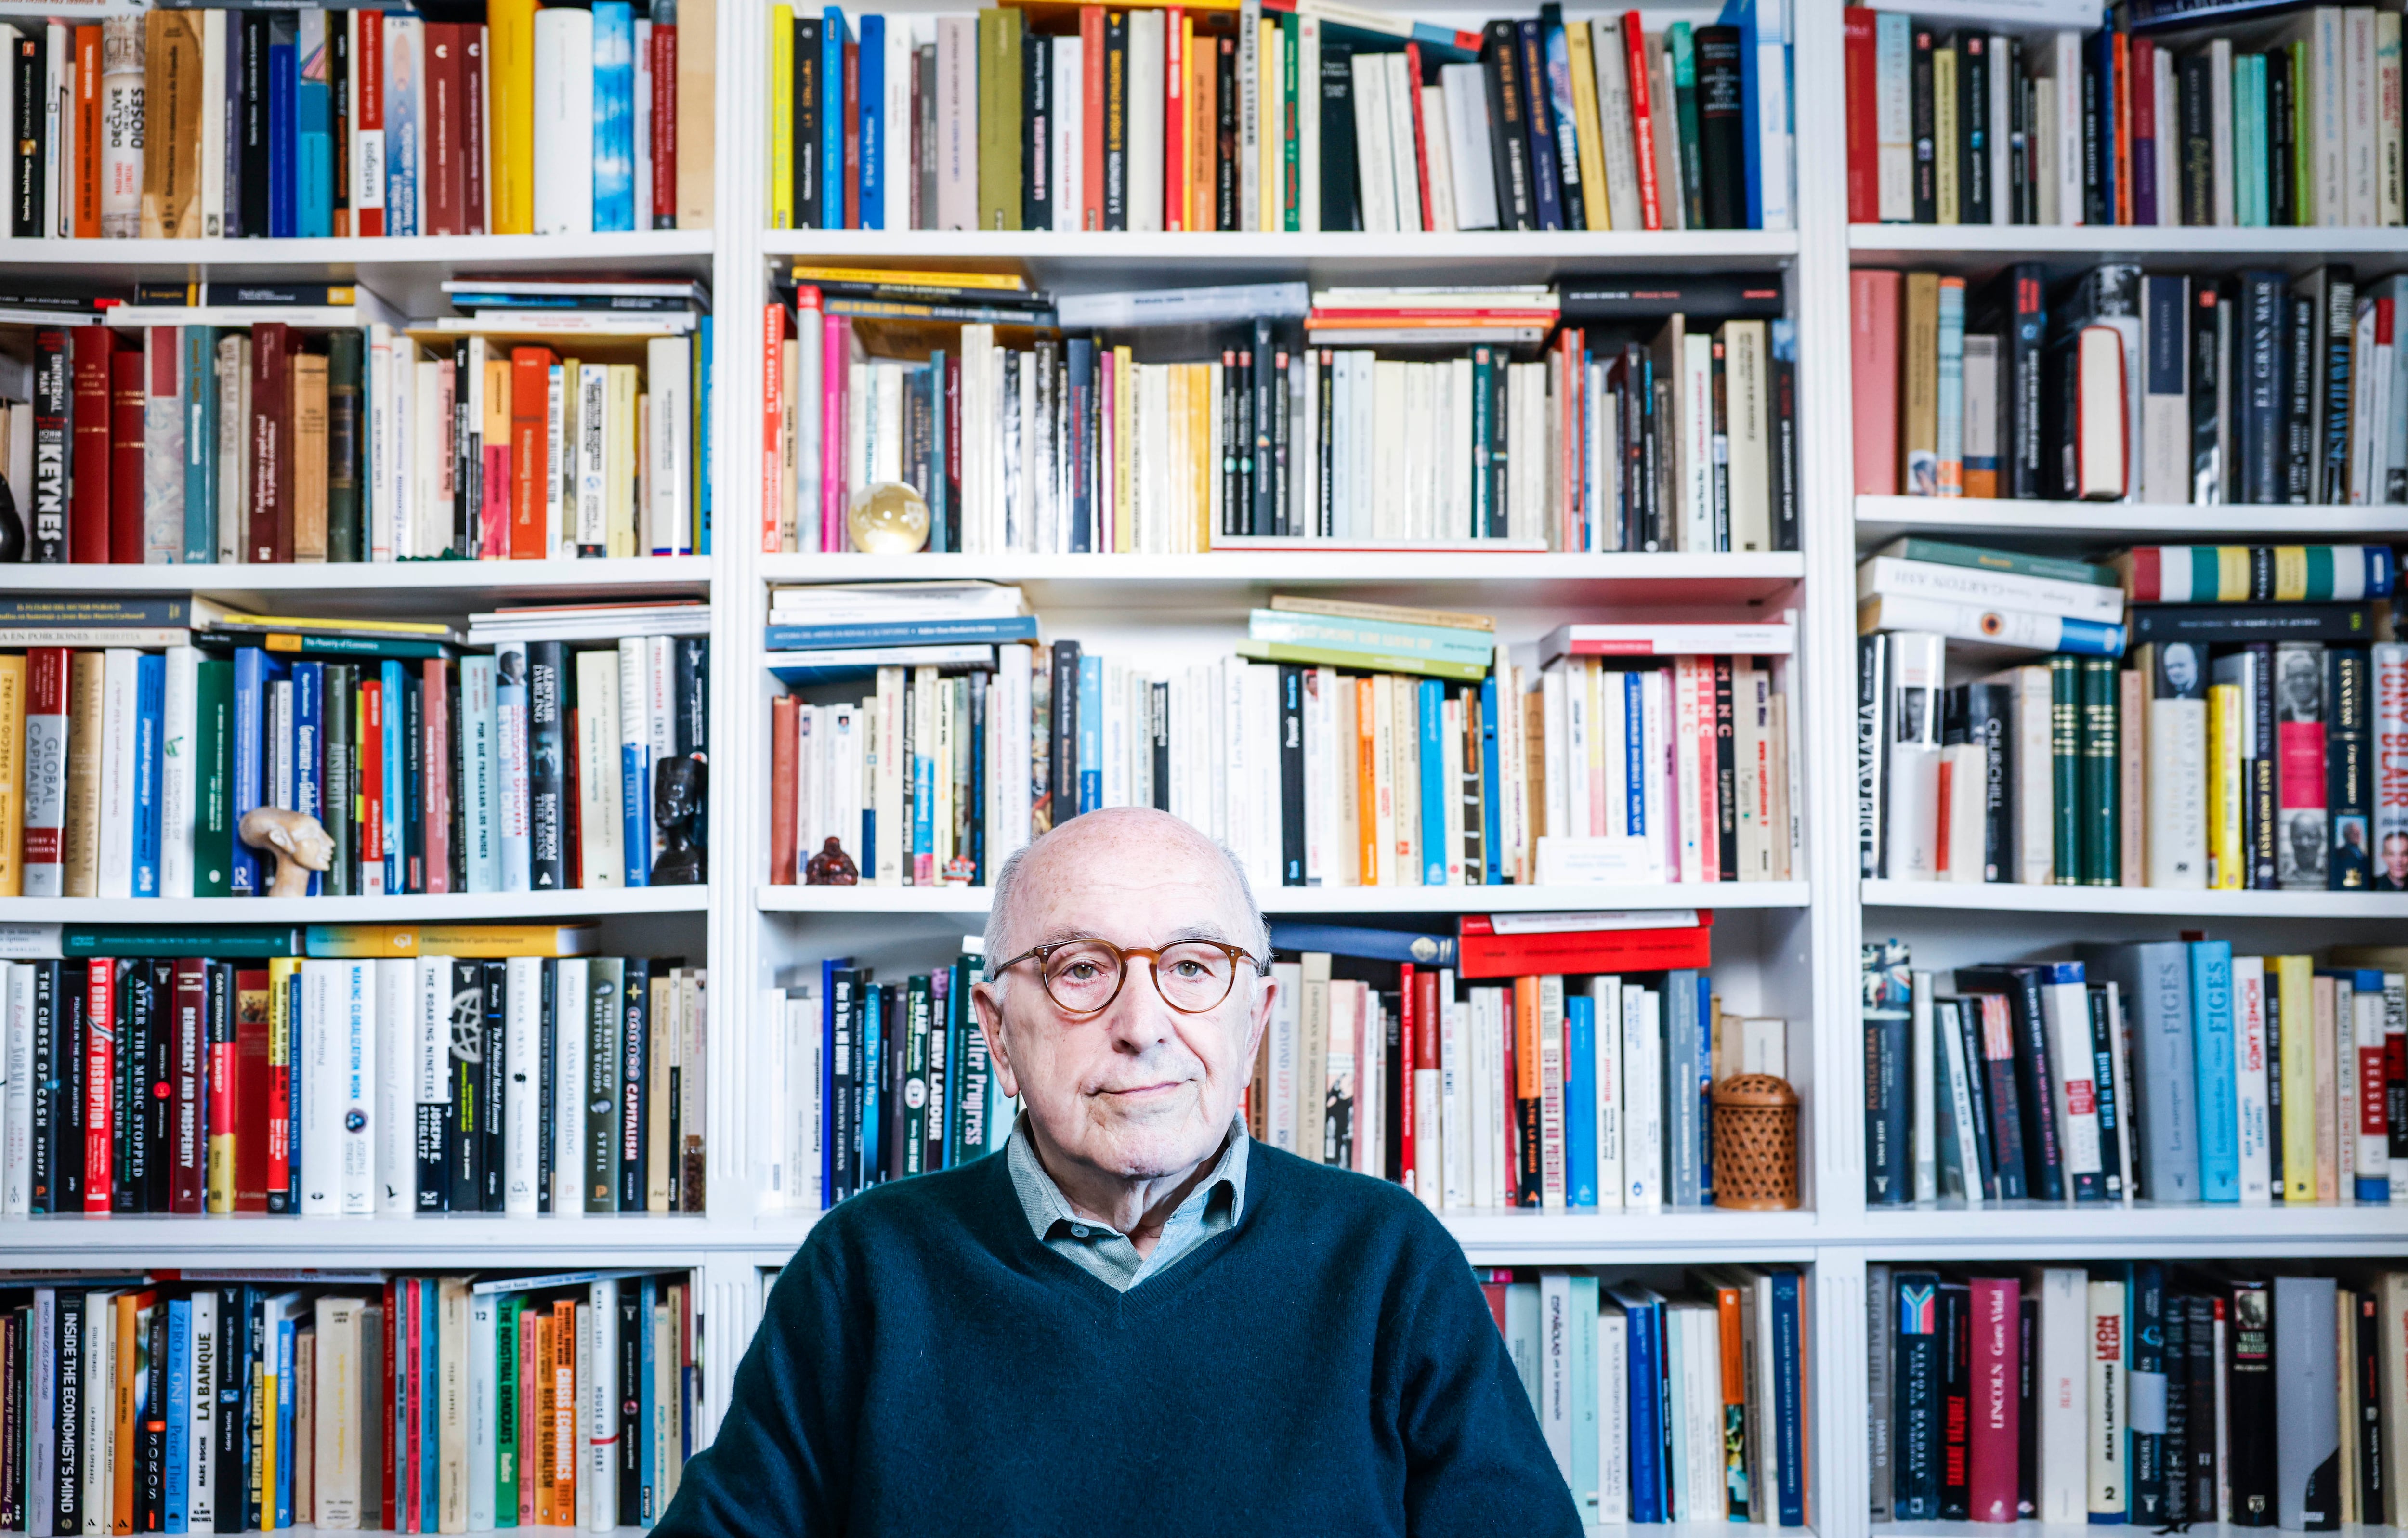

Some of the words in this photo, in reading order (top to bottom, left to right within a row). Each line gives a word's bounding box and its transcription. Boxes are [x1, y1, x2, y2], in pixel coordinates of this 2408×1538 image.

[111, 87, 123, 148] DECLIVE
[130, 87, 144, 149] DIOSES
[361, 142, 376, 198] testigos
[2255, 282, 2270, 322] MAR
[767, 307, 776, 344] DEBATE
[2254, 329, 2270, 378] GRAN
[39, 371, 49, 396] MAN
[50, 354, 63, 413] UNIVERSAL
[767, 359, 776, 398] FUTURO
[2254, 385, 2269, 407] EL
[521, 429, 533, 479] Económica
[37, 444, 63, 541] KEYNES
[519, 482, 532, 524] Dinámica
[11, 632, 25, 641] EN
[28, 630, 90, 641] PORCIONES
[304, 637, 315, 647] The
[315, 637, 336, 649] Poverty
[336, 638, 346, 648] of
[346, 639, 379, 650] Economics
[2, 676, 13, 699] PAZ
[532, 665, 544, 723] DARLING
[544, 665, 555, 722] ALISTAIR
[2381, 661, 2408, 722] TONY
[2, 724, 12, 769] PRECIO
[498, 705, 511, 759] BEYOND
[512, 705, 527, 771] GORDON
[1286, 716, 1299, 747] Pouvoir
[27, 723, 41, 821] CAPITALISM
[43, 737, 59, 806] GLOBAL
[327, 742, 346, 811] AUSTERITY
[499, 764, 511, 787] THE
[1858, 702, 1877, 842] DIPLOMACIA
[1987, 718, 2002, 810] CHURCHILL
[2258, 759, 2270, 792] EAST
[2381, 733, 2408, 808] BLAIR
[70, 795, 80, 814] OF
[85, 788, 95, 816] THE
[500, 791, 512, 838] CRASH
[513, 778, 528, 837] BROWN
[534, 795, 546, 822] THE
[546, 793, 557, 821] BACK
[2259, 795, 2270, 816] AND
[69, 818, 80, 864] MONEY
[84, 821, 96, 873] ASCENT
[372, 849, 378, 858] El
[535, 824, 546, 861] BRINK
[546, 823, 557, 861] FROM
[2259, 818, 2272, 858] WEST
[38, 971, 50, 1000] THE
[91, 966, 107, 982] NO
[351, 966, 362, 1001] MAKING
[425, 968, 435, 989] THE
[837, 983, 849, 1000] Over
[135, 979, 146, 1025] AFTER
[424, 994, 435, 1041] ROARING
[603, 1003, 613, 1025] THE
[836, 1002, 848, 1010] To
[2160, 963, 2181, 1034] FIGES
[2206, 963, 2227, 1033] FIGES
[2340, 991, 2350, 1045] MICHAEL
[37, 1007, 49, 1056] CURSE
[116, 1017, 125, 1056] ALAN
[182, 1007, 196, 1072] DEMOCRACY
[350, 1004, 361, 1073] GLOBALIZATION
[594, 999, 604, 1049] BRETTON
[835, 1012, 848, 1029] You,
[836, 1031, 847, 1043] MR
[2248, 978, 2262, 1072] HOMELANDS
[134, 1030, 145, 1060] THE
[602, 1029, 613, 1071] BATTLE
[835, 1045, 847, 1075] BROWN
[866, 1040, 876, 1056] The
[930, 1030, 944, 1069] NEW
[967, 1029, 987, 1070] After
[1279, 1021, 1291, 1068] BEYOND
[36, 1063, 48, 1080] OF
[116, 1060, 124, 1071] S.
[424, 1046, 435, 1099] NINETIES
[593, 1052, 603, 1093] WOODS
[602, 1074, 612, 1089] OF
[866, 1060, 876, 1083] Third
[1279, 1071, 1291, 1100] LEFT
[1603, 1058, 1611, 1102] Mitterrand
[2341, 1051, 2351, 1091] LEWIS
[89, 1056, 105, 1129] DISRUPTION
[134, 1065, 145, 1109] MUSIC
[181, 1077, 194, 1100] AND
[350, 1075, 361, 1100] WORK
[864, 1086, 875, 1106] Way
[928, 1072, 944, 1141] LABOUR
[1681, 1063, 1690, 1113] MITTERRAND
[2367, 1057, 2381, 1125] REASON
[35, 1088, 48, 1127] CASH
[115, 1078, 124, 1139] BLINDER
[430, 1106, 441, 1148] JOSEPH
[625, 1083, 638, 1160] CAPITALISM
[837, 1087, 846, 1129] ANTHONY
[964, 1074, 986, 1145] Progress
[1279, 1102, 1291, 1127] AND
[2243, 1098, 2251, 1136] GARTON
[133, 1114, 144, 1177] STOPPED
[180, 1103, 194, 1168] PROSPERITY
[418, 1106, 428, 1159] STIGLITZ
[596, 1132, 606, 1172] STEIL
[837, 1132, 845, 1171] GIDDENS
[1682, 1116, 1691, 1170] EXPERIMENTO
[2244, 1140, 2253, 1158] ASH
[2341, 1096, 2352, 1174] BOOMERANG
[36, 1137, 46, 1177] ROGOFF
[430, 1152, 441, 1164] E.
[1683, 1173, 1690, 1181] EL
[500, 1307, 512, 1325] THE
[1990, 1290, 2005, 1322] Vidal
[62, 1313, 77, 1356] INSIDE
[171, 1313, 184, 1353] ZERO
[280, 1334, 290, 1366] INVESTING
[62, 1357, 76, 1385] THE
[197, 1333, 211, 1396] BANQUE
[500, 1328, 512, 1383] INDUSTRIAL
[1915, 1343, 1926, 1400] NELSON
[170, 1372, 183, 1404] ONE
[280, 1379, 289, 1405] CHANGE
[543, 1388, 553, 1409] RISE
[556, 1369, 572, 1408] CRISIS
[594, 1386, 603, 1419] HOUSE
[1990, 1364, 2005, 1429] LINCOLN
[197, 1401, 210, 1420] LA
[500, 1385, 512, 1444] DEMOCRATS
[543, 1412, 553, 1428] TO
[594, 1424, 603, 1435] OF
[61, 1387, 75, 1475] ECONOMIST'S
[168, 1425, 182, 1458] Peter
[198, 1436, 208, 1461] ROCHE
[556, 1411, 571, 1480] ECONOMICS
[1915, 1409, 1925, 1480] MANDELA
[147, 1434, 158, 1499] SOROS
[168, 1463, 181, 1496] Thiel
[198, 1465, 207, 1486] MARC
[500, 1453, 512, 1483] Radice
[542, 1431, 553, 1488] GLOBALISM
[594, 1448, 603, 1473] DEBT
[60, 1477, 75, 1513] MIND
